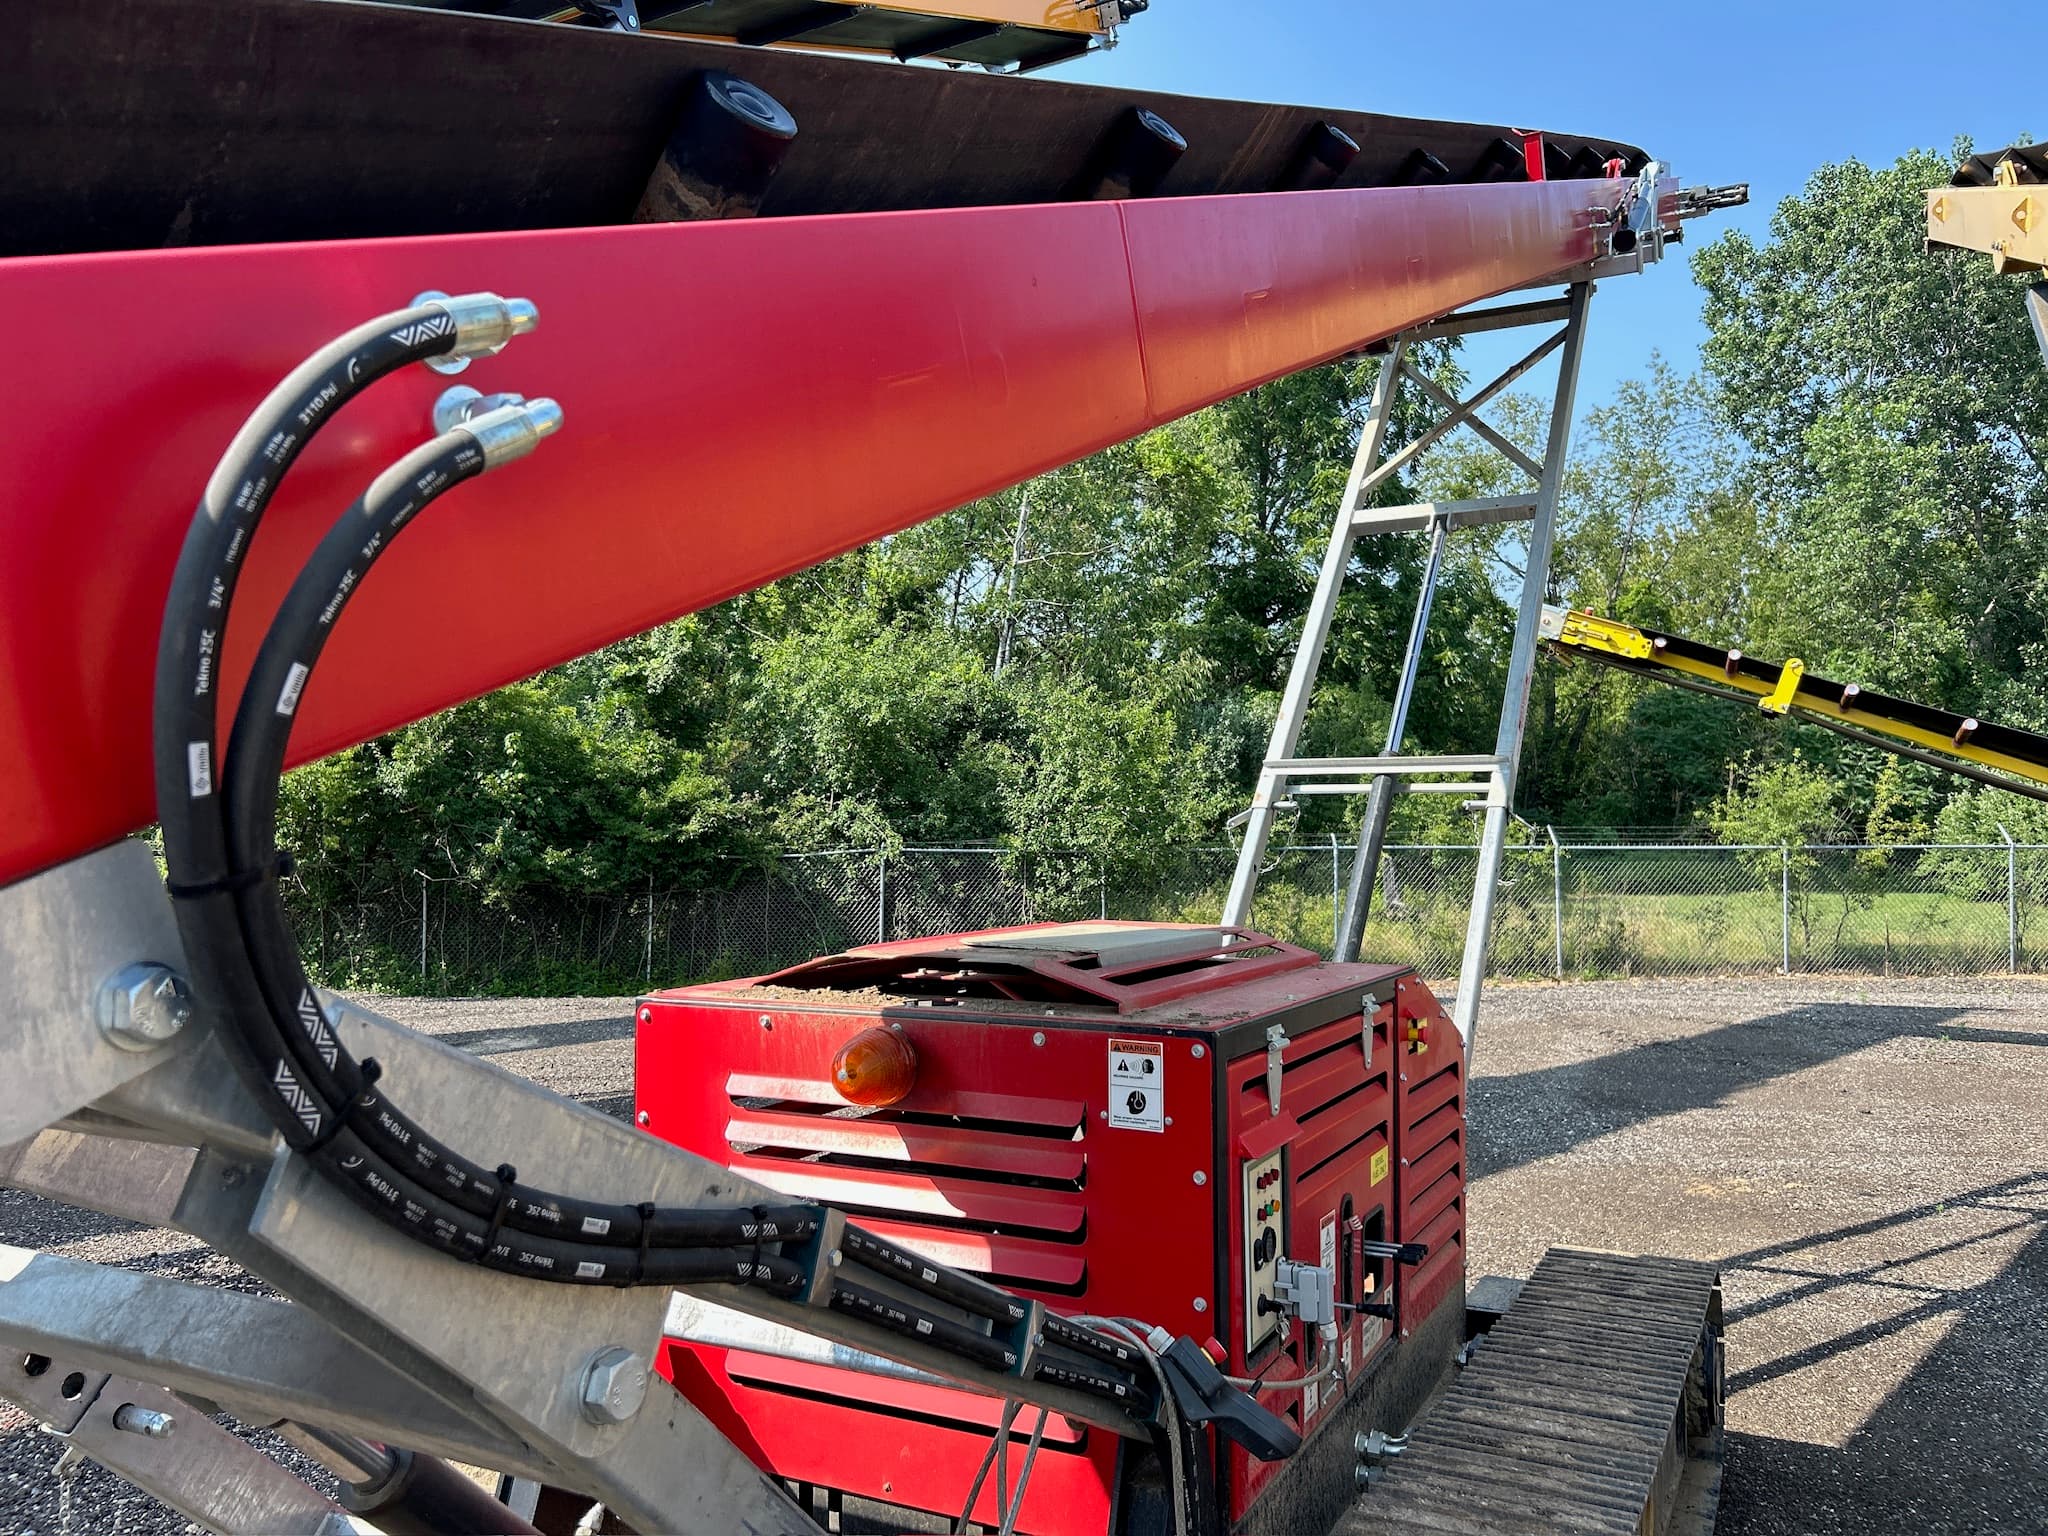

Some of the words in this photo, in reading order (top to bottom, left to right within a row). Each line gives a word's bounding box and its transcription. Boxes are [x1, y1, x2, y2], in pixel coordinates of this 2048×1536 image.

[298, 397, 325, 425] 3110
[320, 382, 338, 402] Psi
[362, 531, 380, 558] 3/4"
[208, 575, 225, 608] 3/4"
[319, 593, 344, 624] Tekno
[338, 568, 357, 592] 2SC
[200, 629, 216, 654] 2SC
[194, 658, 211, 695] Tekno
[1121, 1043, 1159, 1053] WARNING
[380, 1111, 393, 1127] Psi
[391, 1122, 411, 1143] 3110
[367, 1171, 381, 1187] Psi
[378, 1181, 400, 1201] 3110
[507, 1198, 518, 1209] 3/
[527, 1204, 541, 1217] 2SC
[541, 1208, 561, 1222] Tekno
[491, 1244, 511, 1256] 3/4"
[520, 1251, 535, 1263] 2SC
[534, 1255, 554, 1268] Tekno
